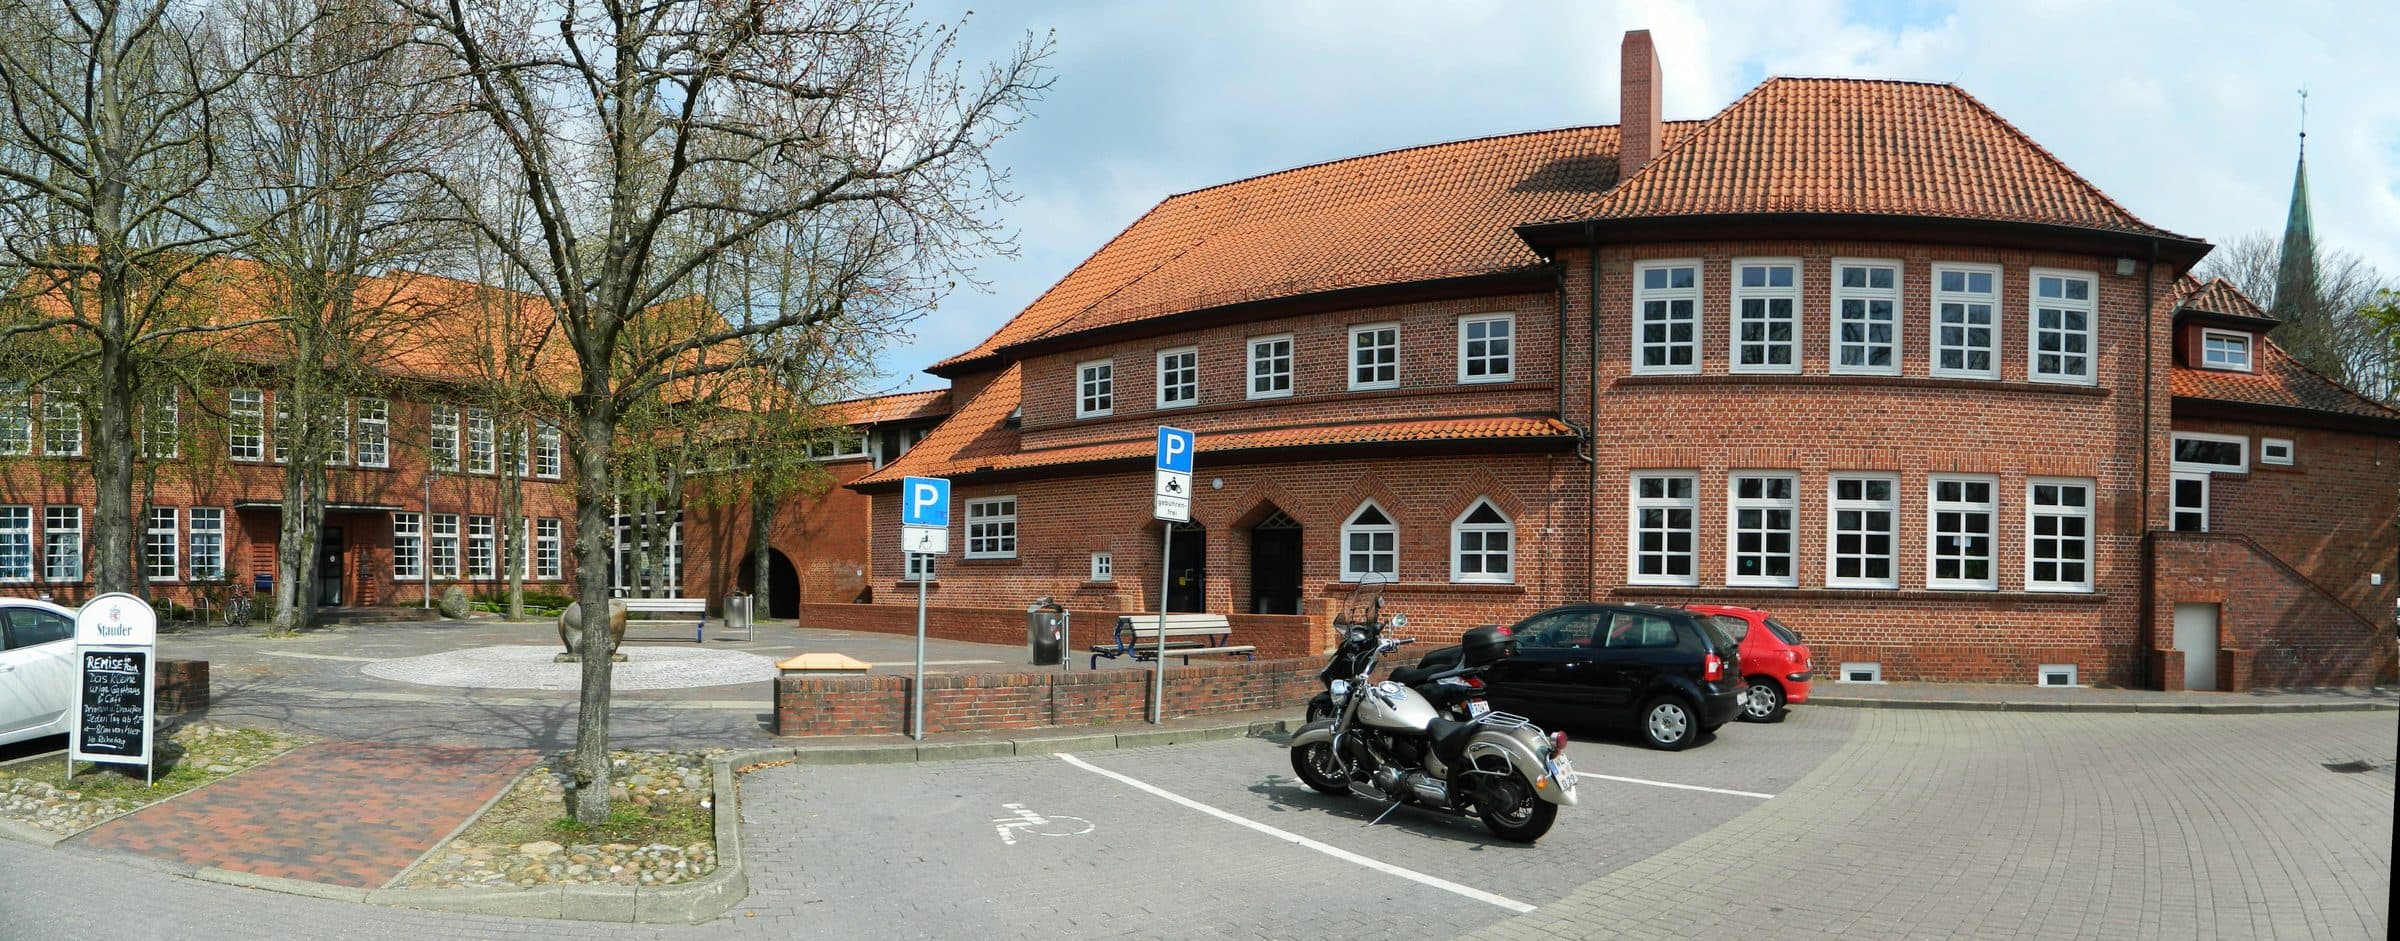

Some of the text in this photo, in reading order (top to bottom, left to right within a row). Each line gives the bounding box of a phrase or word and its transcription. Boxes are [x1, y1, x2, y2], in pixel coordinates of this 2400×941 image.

[1166, 433, 1185, 465] P
[913, 483, 939, 519] P
[97, 623, 133, 638] Stauder
